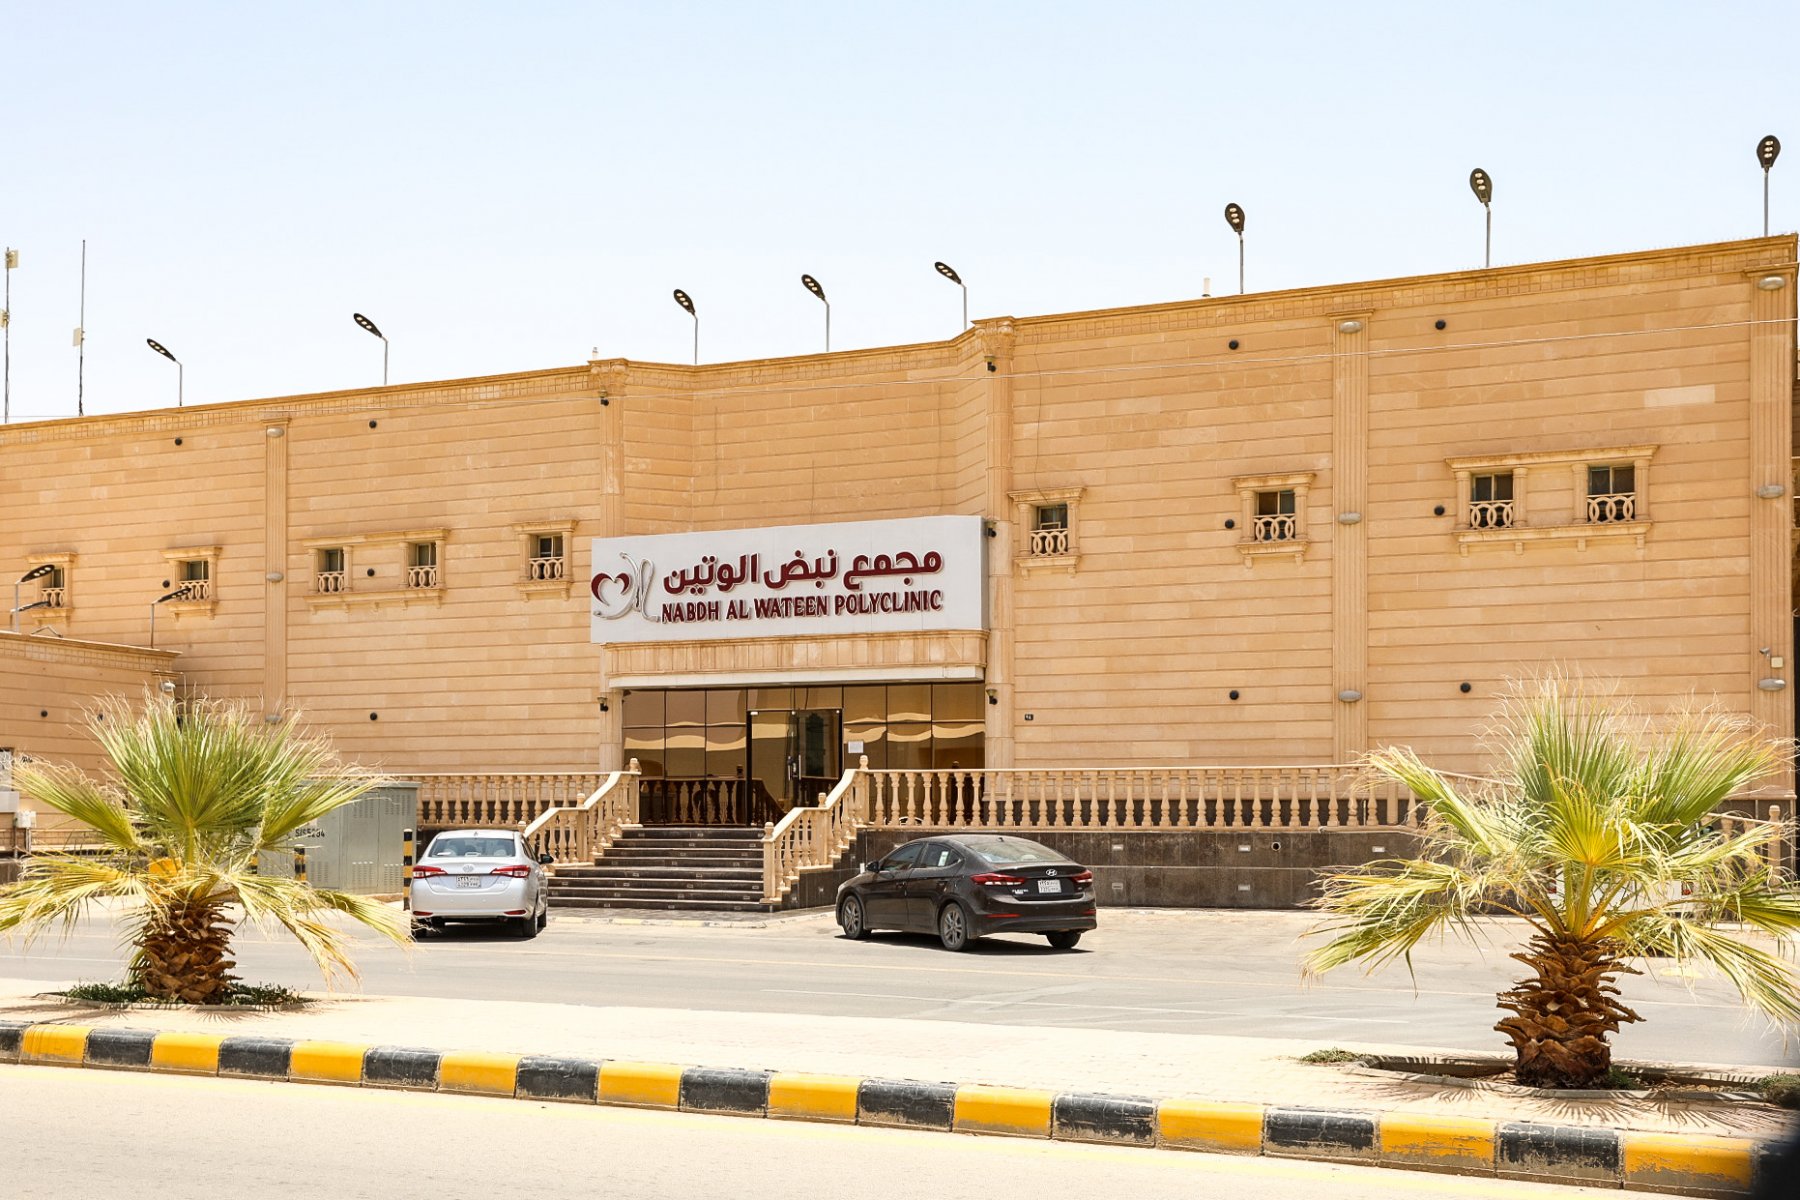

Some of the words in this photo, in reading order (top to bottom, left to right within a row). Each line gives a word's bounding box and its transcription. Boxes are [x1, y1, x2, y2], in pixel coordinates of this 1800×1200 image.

[663, 553, 758, 594] الوتين
[763, 549, 837, 589] نبض
[843, 551, 942, 590] مجمع
[662, 601, 719, 623] NABDH
[726, 600, 749, 620] AL
[754, 595, 828, 618] WATEEN
[834, 589, 943, 616] POLYCLINIC
